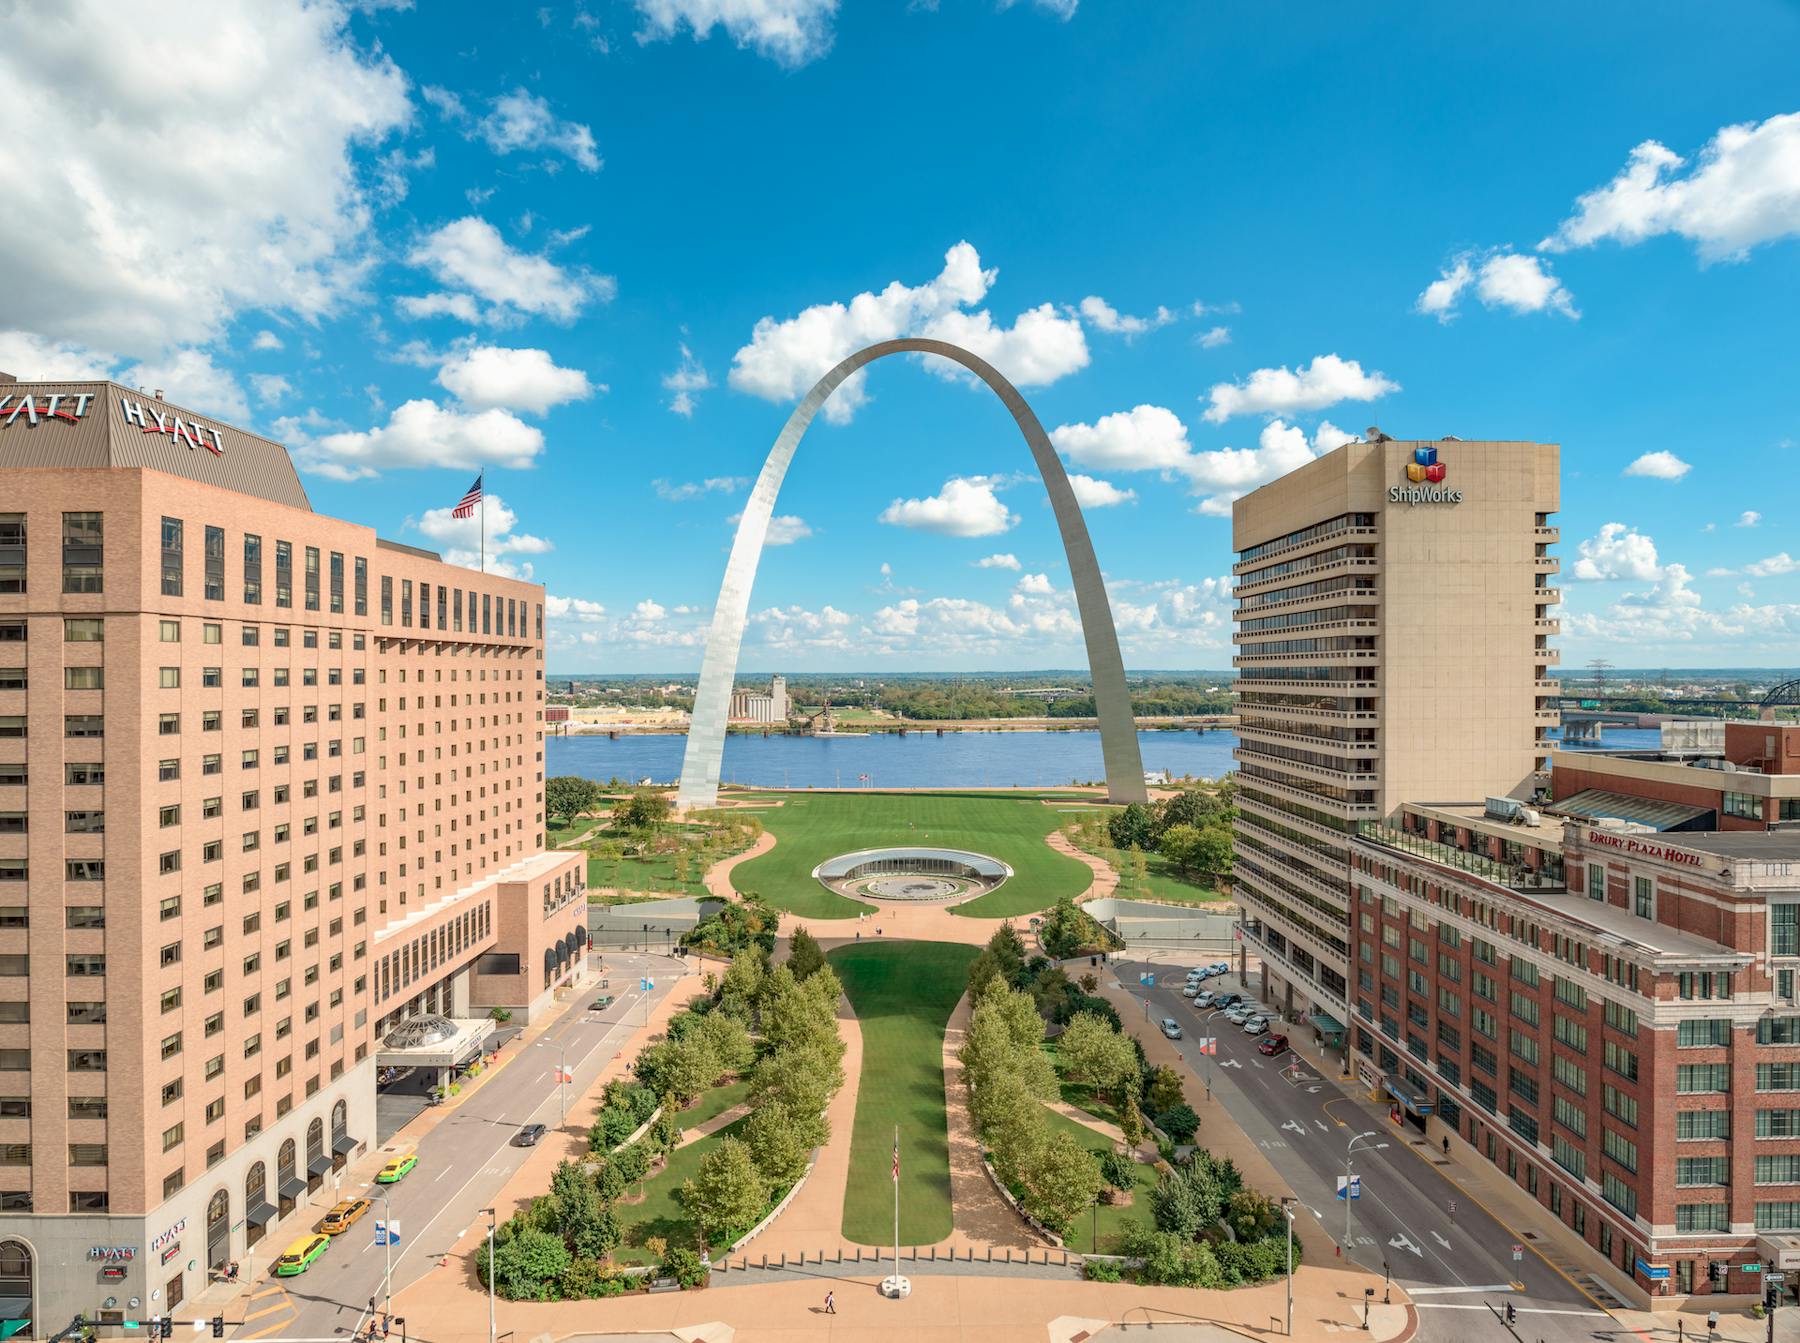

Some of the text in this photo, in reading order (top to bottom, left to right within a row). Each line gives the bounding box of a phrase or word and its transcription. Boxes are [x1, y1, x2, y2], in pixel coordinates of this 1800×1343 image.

[121, 398, 224, 452] HYATT
[1390, 486, 1463, 506] ShipWorks
[1589, 831, 1702, 868] DRURY PLAZA HOTEL
[152, 1217, 187, 1251] HYATT
[90, 1247, 137, 1259] HYATT
